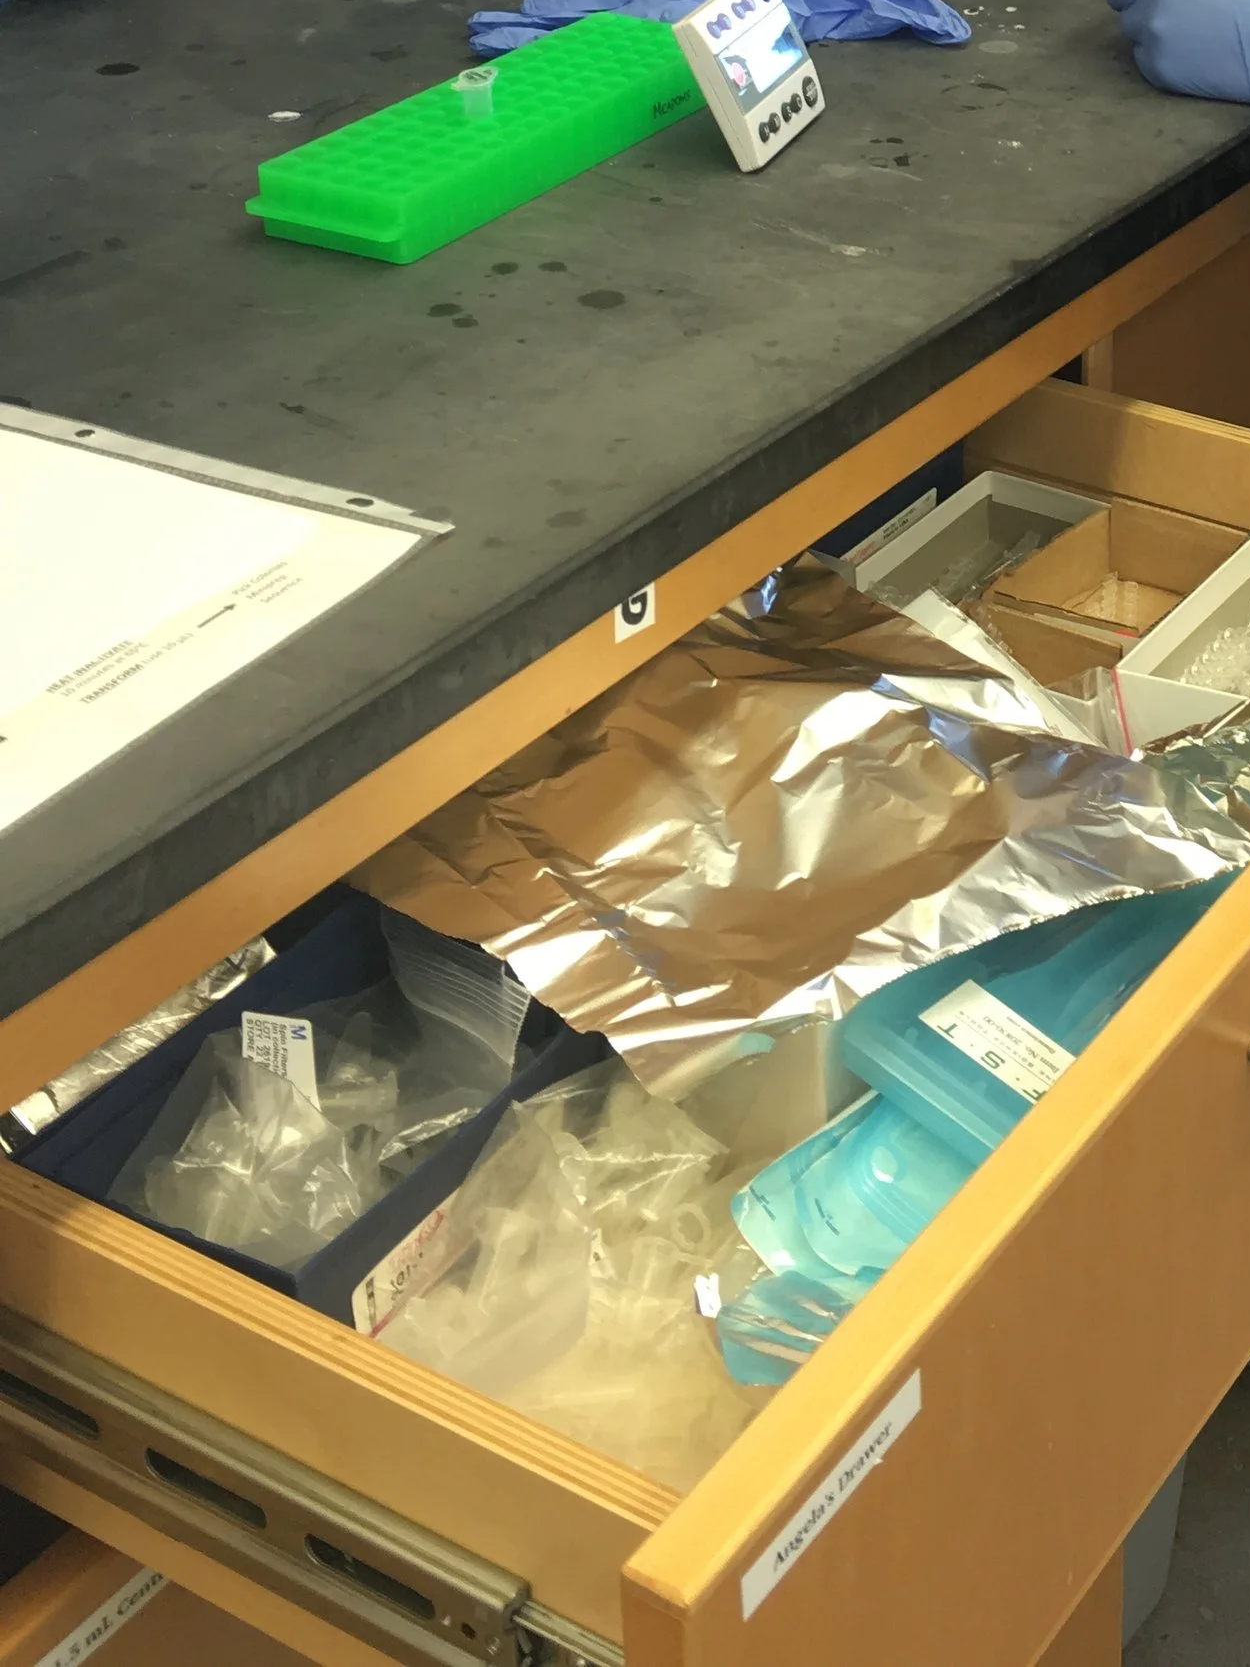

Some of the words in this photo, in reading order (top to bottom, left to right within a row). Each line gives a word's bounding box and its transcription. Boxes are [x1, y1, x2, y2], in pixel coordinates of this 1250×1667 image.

[246, 1018, 256, 1052] STORE
[262, 1020, 271, 1040] LOT
[838, 1421, 892, 1493] Drawer
